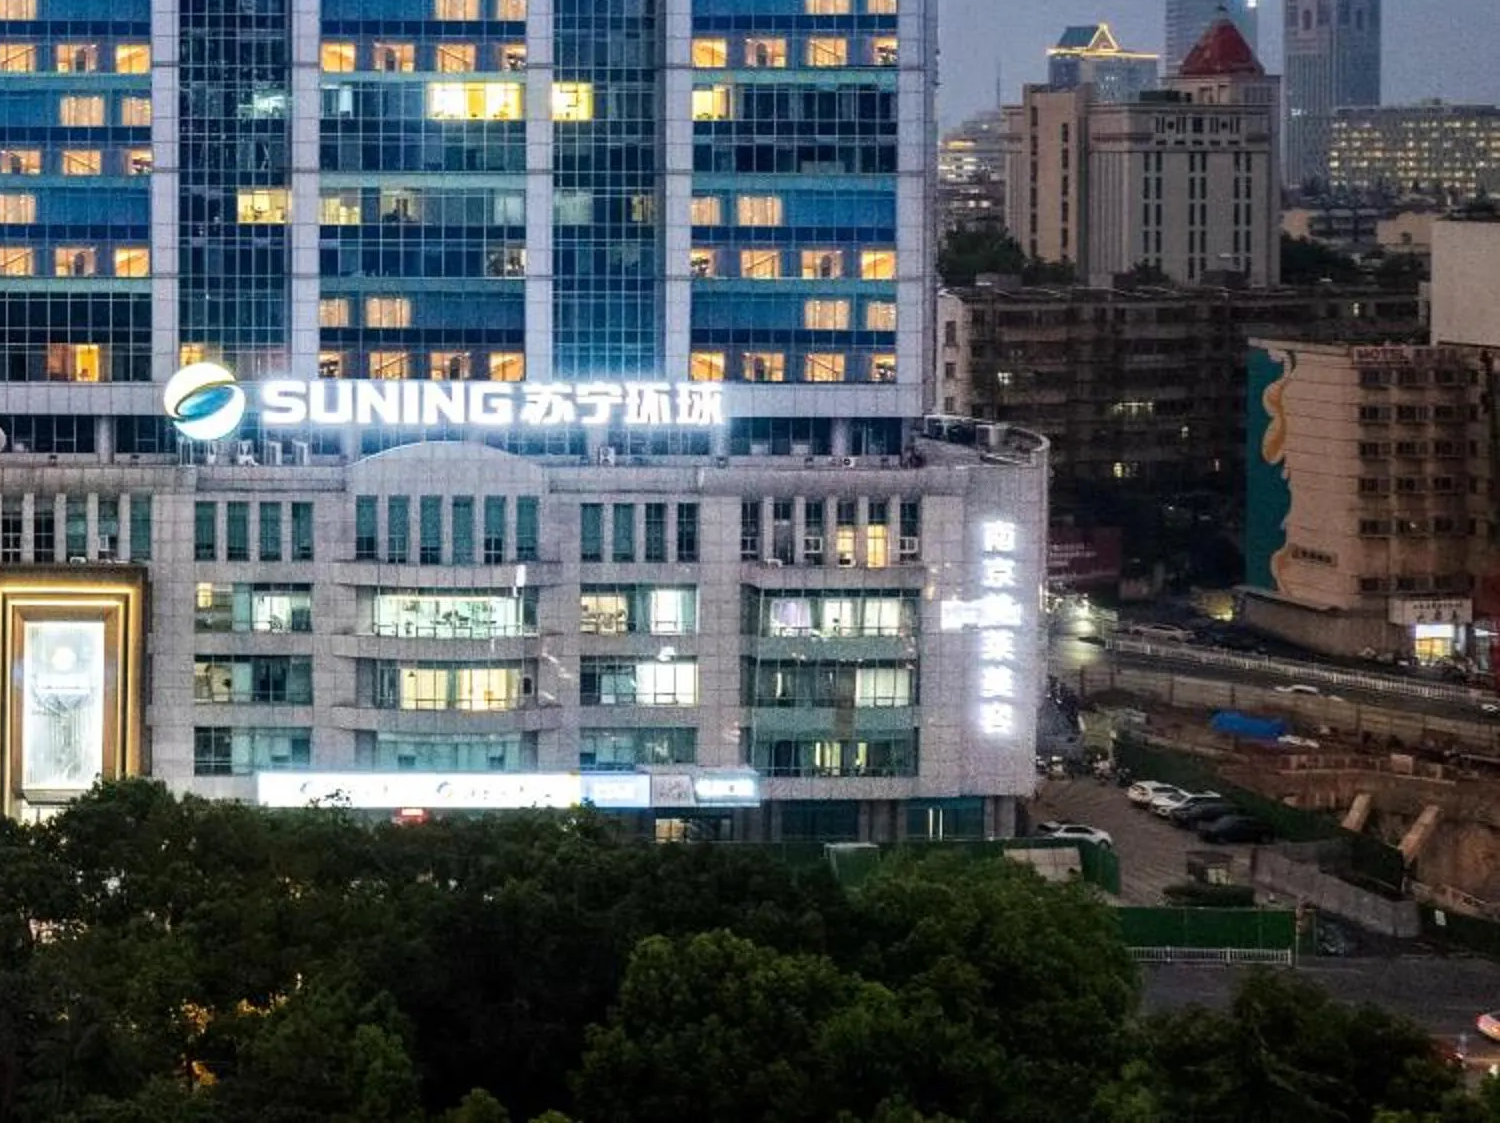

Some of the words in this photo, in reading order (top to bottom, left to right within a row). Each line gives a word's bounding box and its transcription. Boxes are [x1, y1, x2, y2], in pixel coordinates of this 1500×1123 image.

[263, 381, 516, 425] SUNING
[522, 382, 724, 425] 苏宁环球
